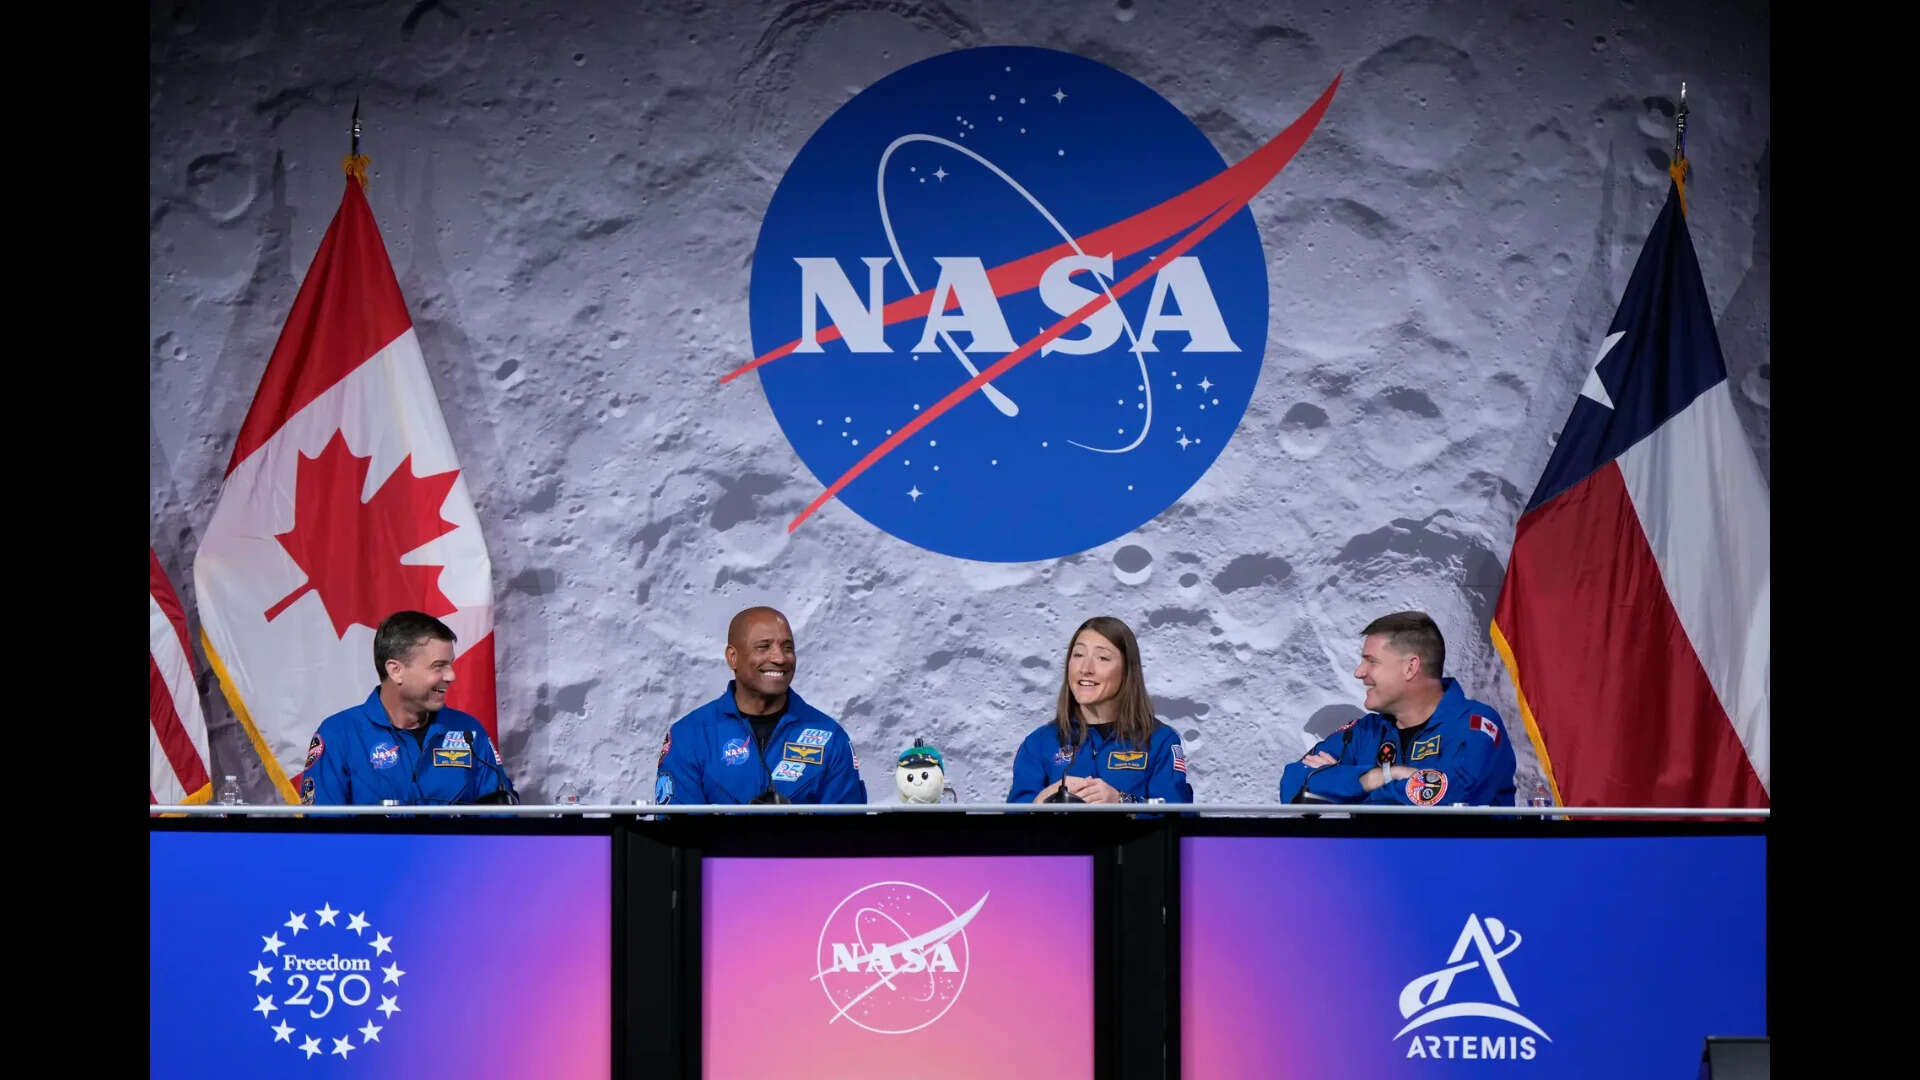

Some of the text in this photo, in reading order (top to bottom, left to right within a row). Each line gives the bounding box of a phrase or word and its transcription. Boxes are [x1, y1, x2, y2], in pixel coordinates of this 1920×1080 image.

[793, 252, 1242, 358] NASA
[725, 747, 748, 757] NASA
[283, 953, 371, 971] Freedom
[832, 943, 960, 973] NASA
[284, 972, 371, 1019] 250
[1406, 1035, 1536, 1060] ARTEMIS
